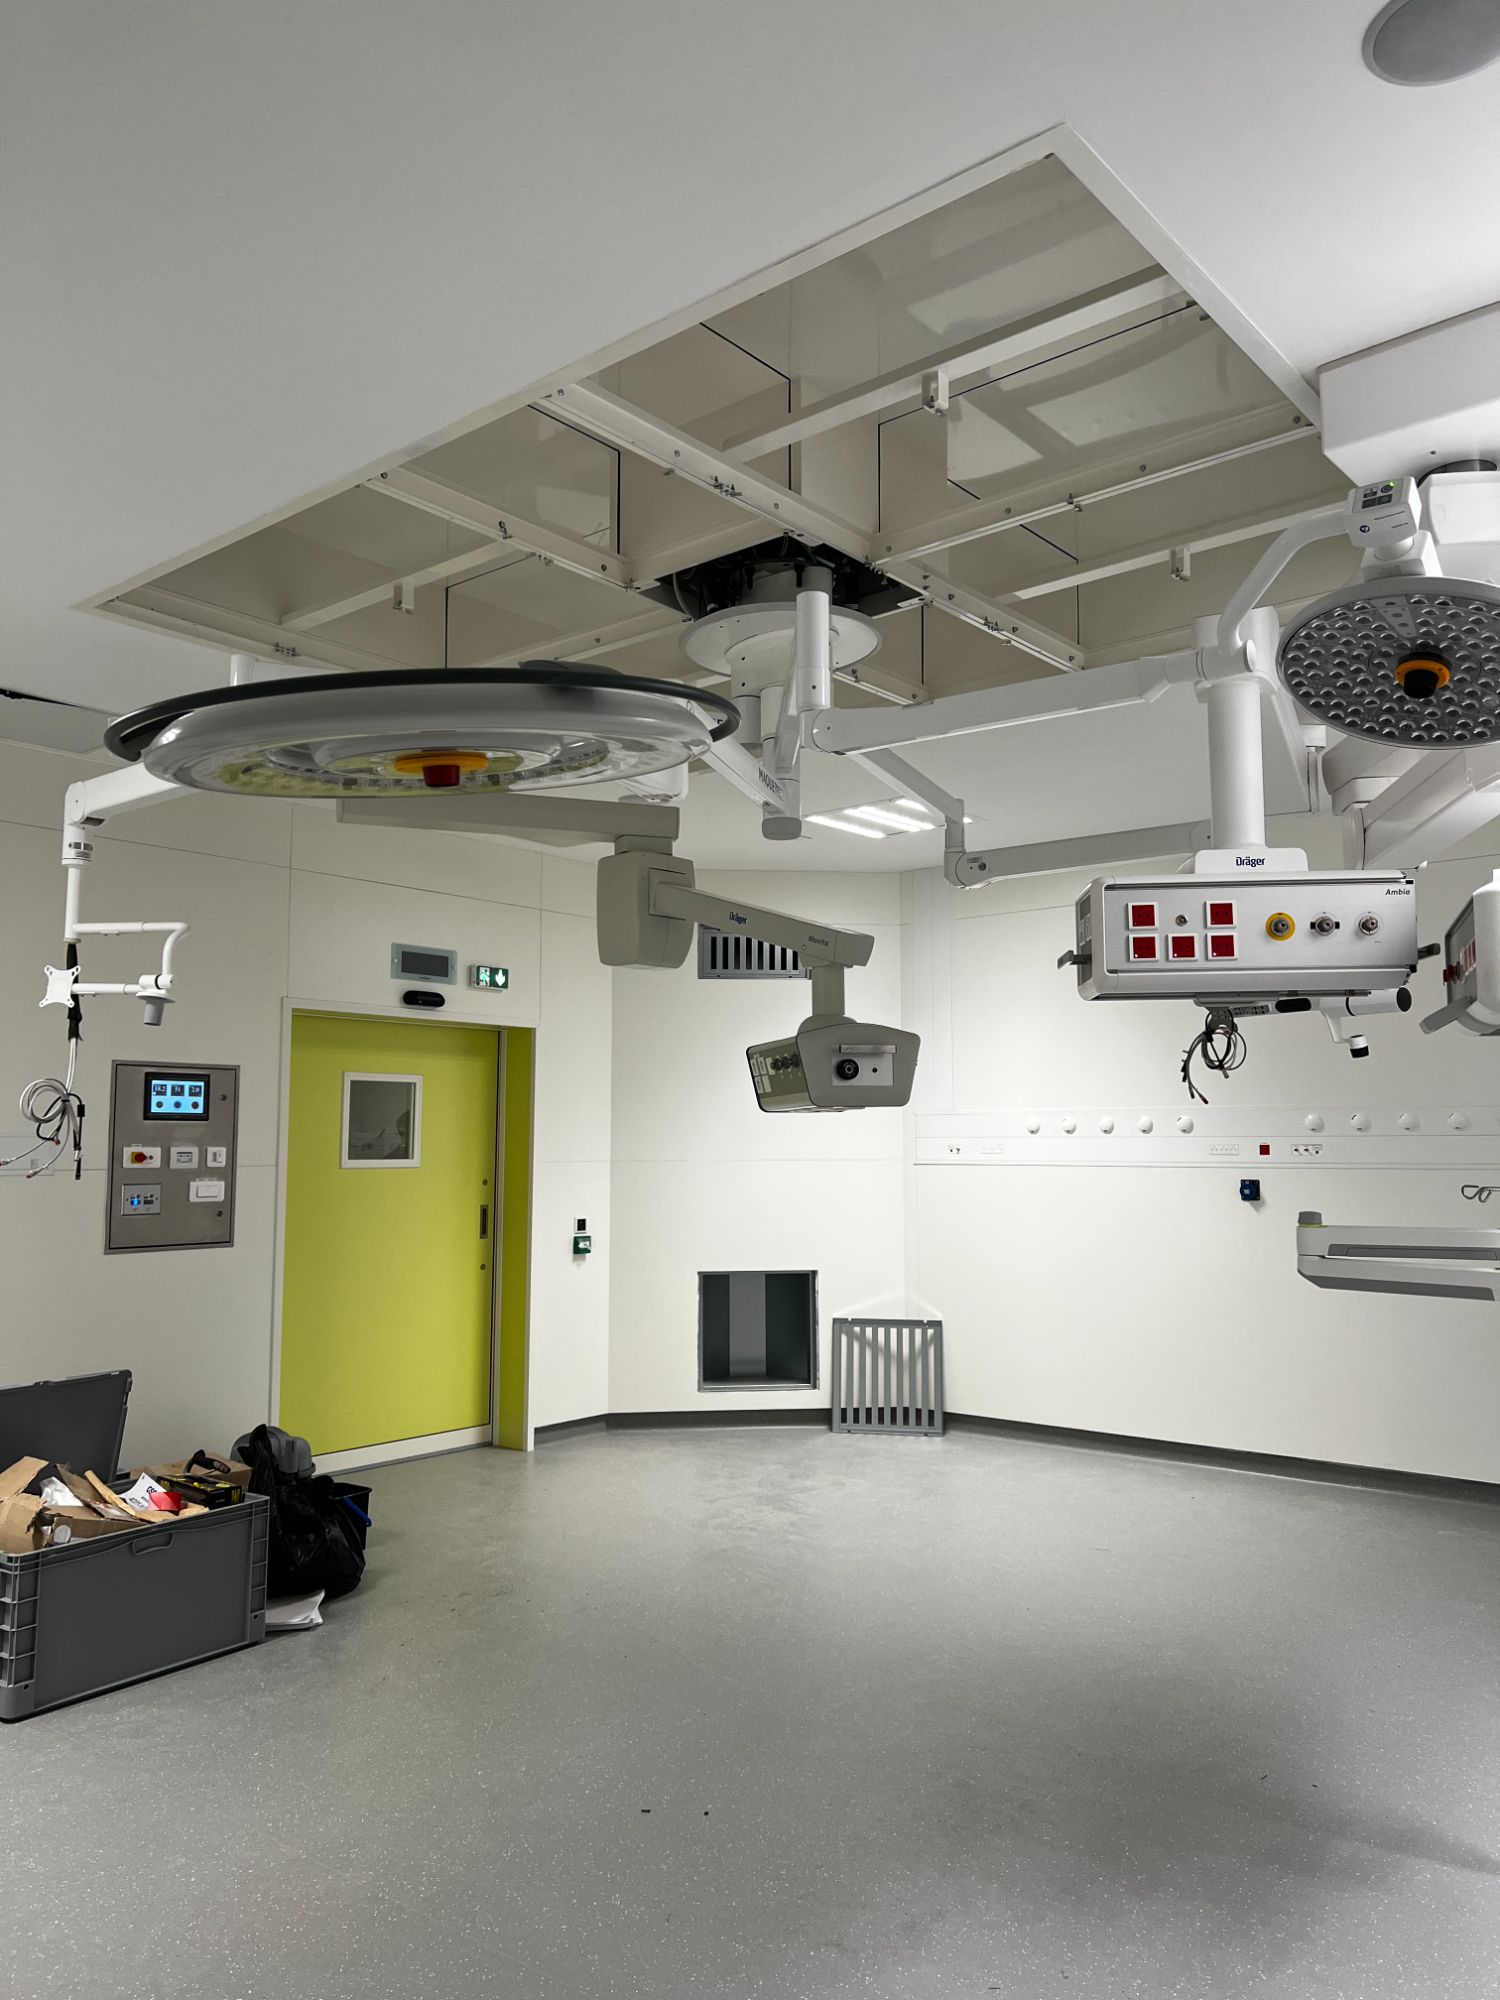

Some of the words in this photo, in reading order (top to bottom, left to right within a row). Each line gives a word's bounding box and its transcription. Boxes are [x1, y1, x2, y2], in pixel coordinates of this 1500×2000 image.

[1235, 856, 1266, 867] Dräger
[1385, 888, 1411, 896] Ambia
[729, 911, 748, 925] Dräger
